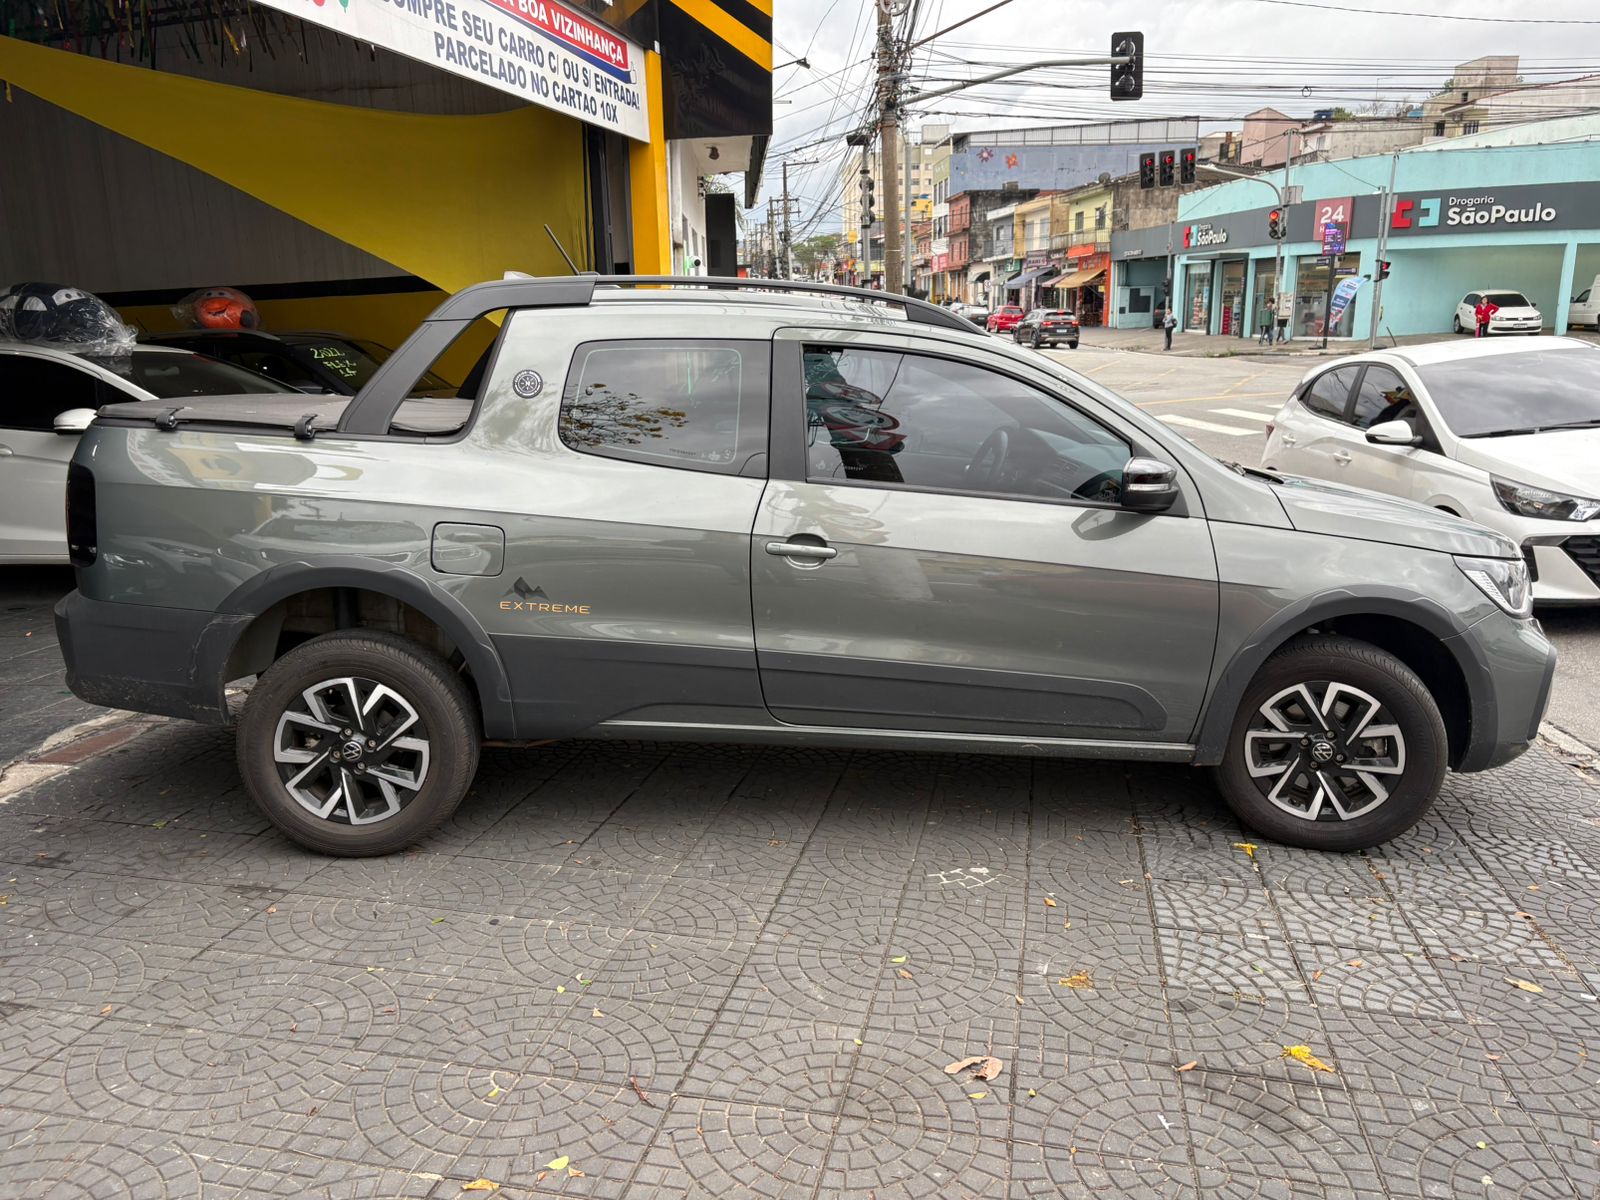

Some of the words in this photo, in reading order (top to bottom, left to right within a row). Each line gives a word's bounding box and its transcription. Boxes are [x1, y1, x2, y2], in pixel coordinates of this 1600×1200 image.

[518, 0, 549, 25] BOA
[550, 8, 625, 64] VIZINHANÇA
[384, 0, 458, 31] MPRE
[461, 10, 493, 46] SEU
[498, 27, 544, 68] CARRO
[548, 51, 559, 75] C/
[562, 58, 579, 83] OU
[593, 73, 640, 111] ENTRADA!
[434, 31, 527, 89] PARCELADO
[530, 70, 549, 98] NO
[552, 80, 597, 116] CARTAO
[600, 101, 618, 123] 10X
[1448, 196, 1495, 206] Drogaria
[1320, 205, 1344, 223] 24
[1446, 202, 1556, 225] SãoPaulo
[499, 601, 591, 615] EXTREME
